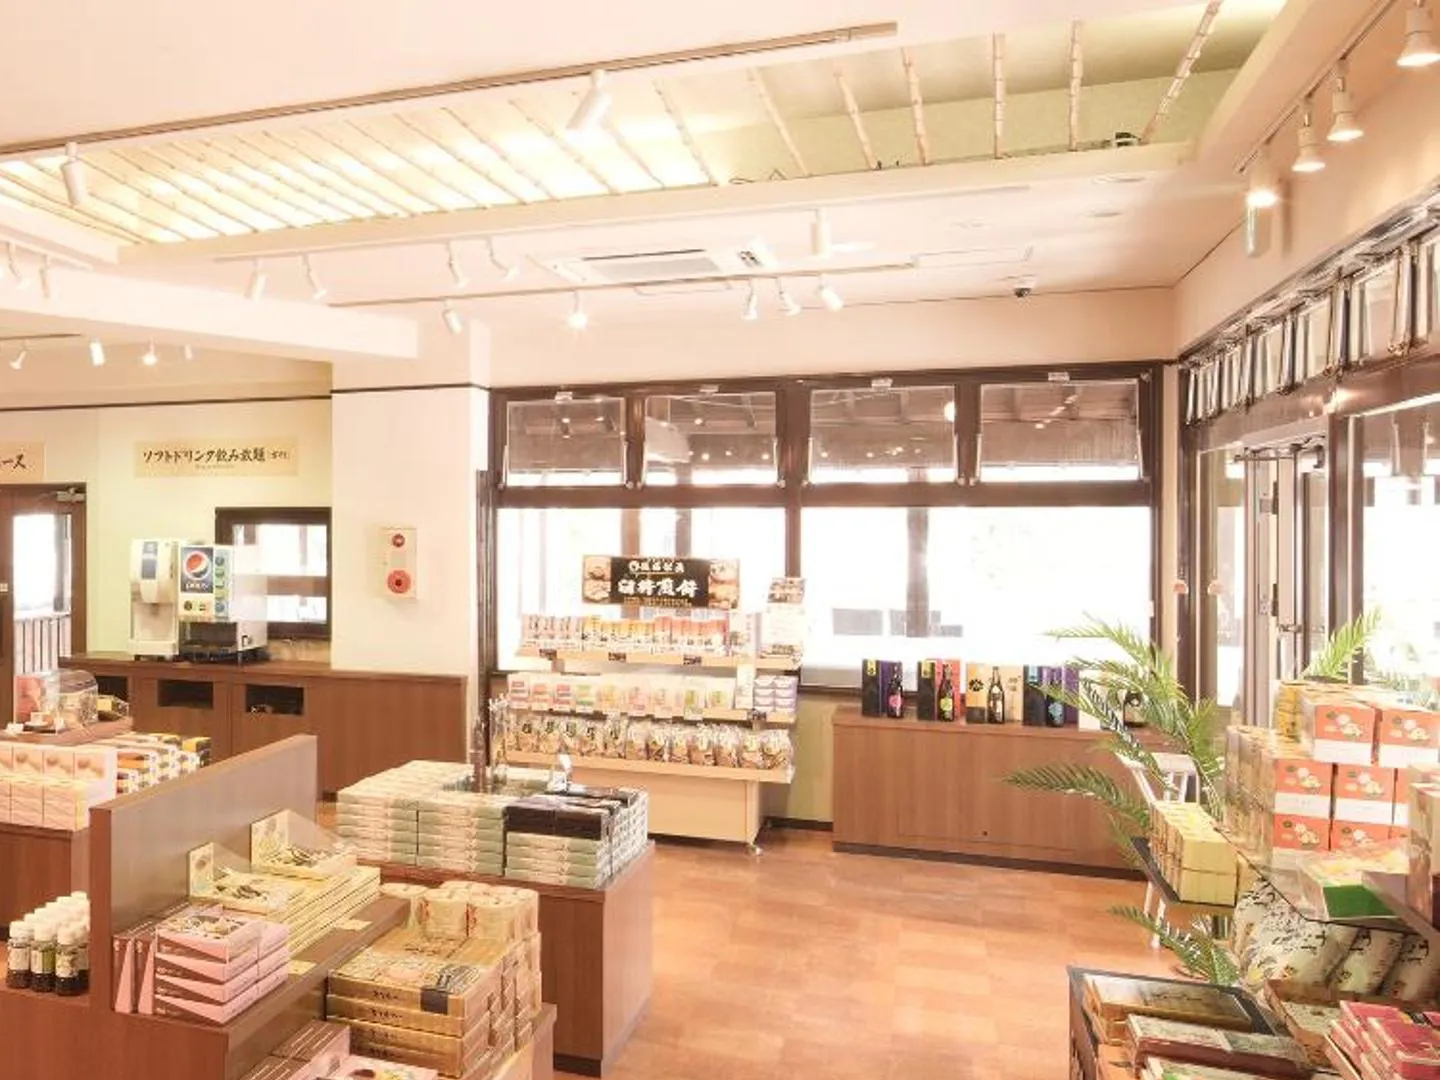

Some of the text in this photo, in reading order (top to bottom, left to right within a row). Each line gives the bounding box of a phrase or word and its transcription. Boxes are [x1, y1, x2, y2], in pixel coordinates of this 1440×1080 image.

[143, 447, 266, 464] ソフトドリンク飲み放題
